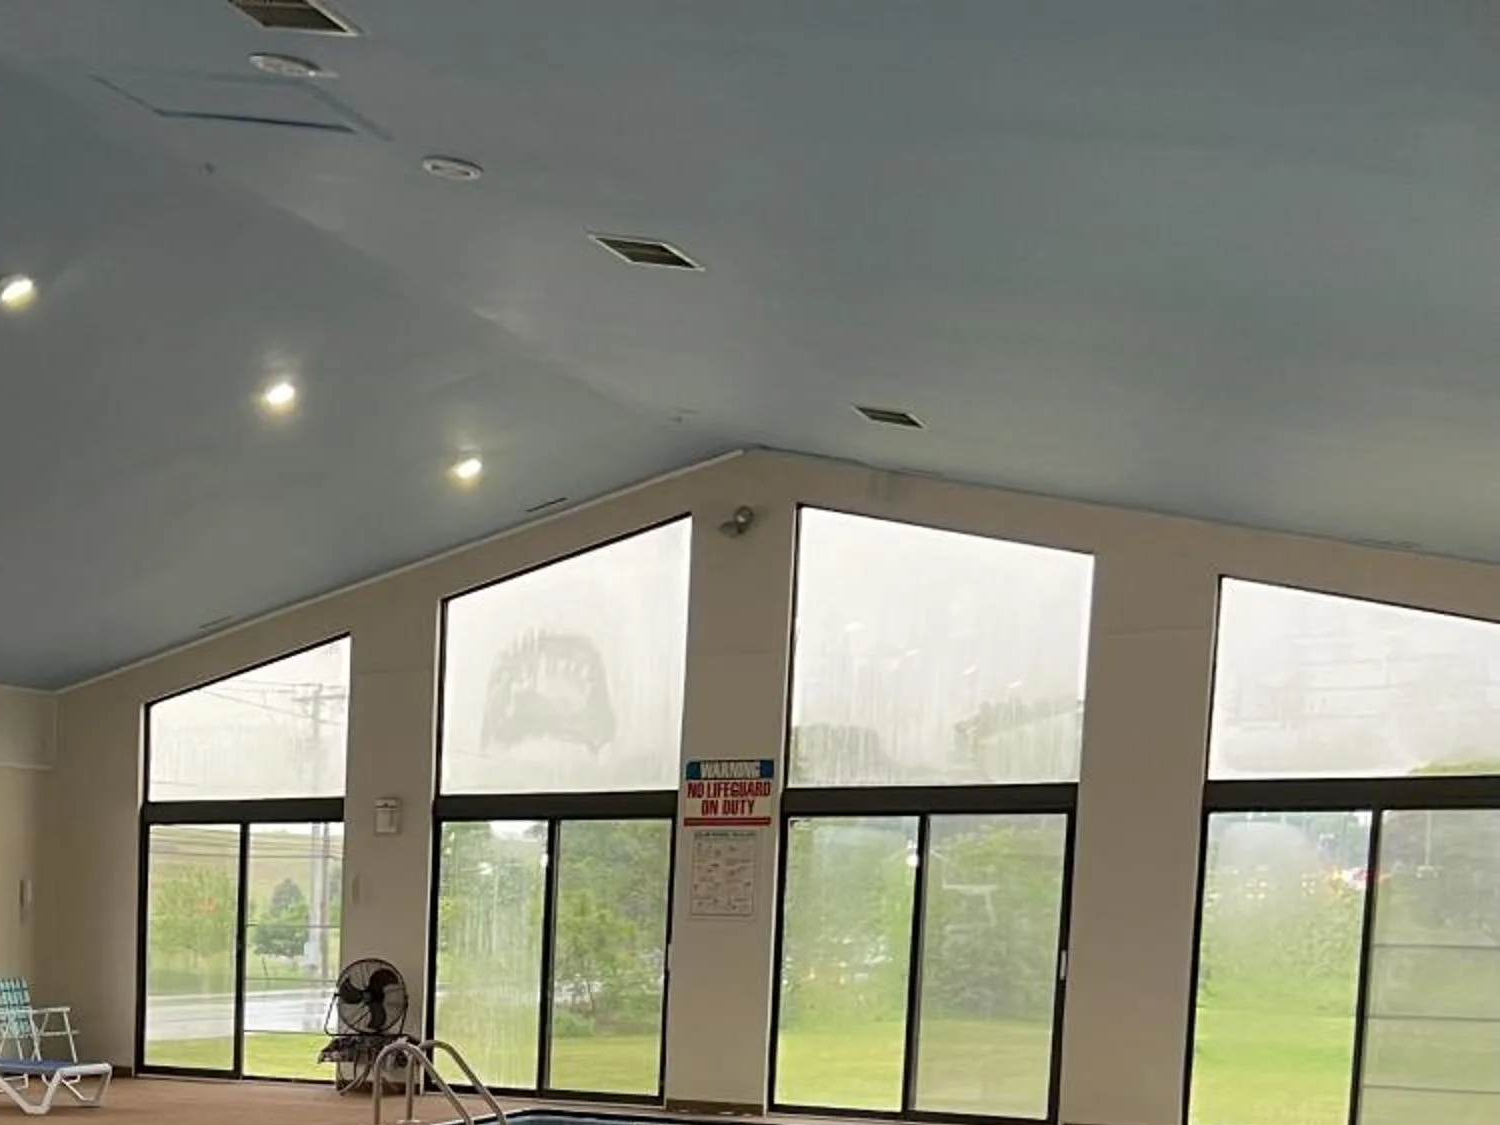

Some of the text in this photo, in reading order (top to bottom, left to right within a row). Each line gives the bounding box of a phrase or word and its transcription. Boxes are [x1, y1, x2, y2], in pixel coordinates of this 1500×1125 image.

[687, 781, 771, 798] NO LIFEGUARD
[701, 799, 755, 816] ON DUTY
